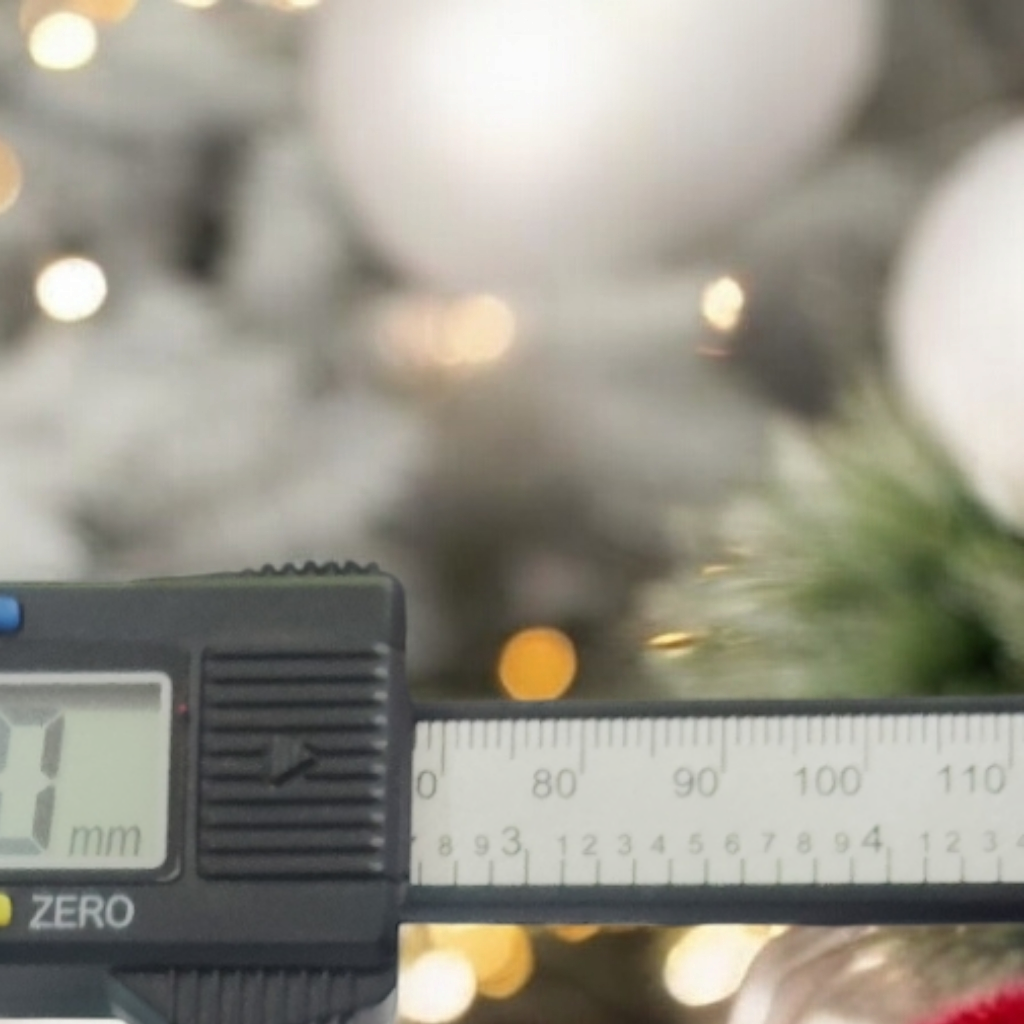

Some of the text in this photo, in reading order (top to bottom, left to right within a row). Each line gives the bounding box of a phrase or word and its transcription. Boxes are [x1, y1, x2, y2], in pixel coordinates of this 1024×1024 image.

[415, 763, 1007, 800] 0 80 90 100 110
[68, 824, 142, 858] mm
[28, 894, 135, 930] ZERO
